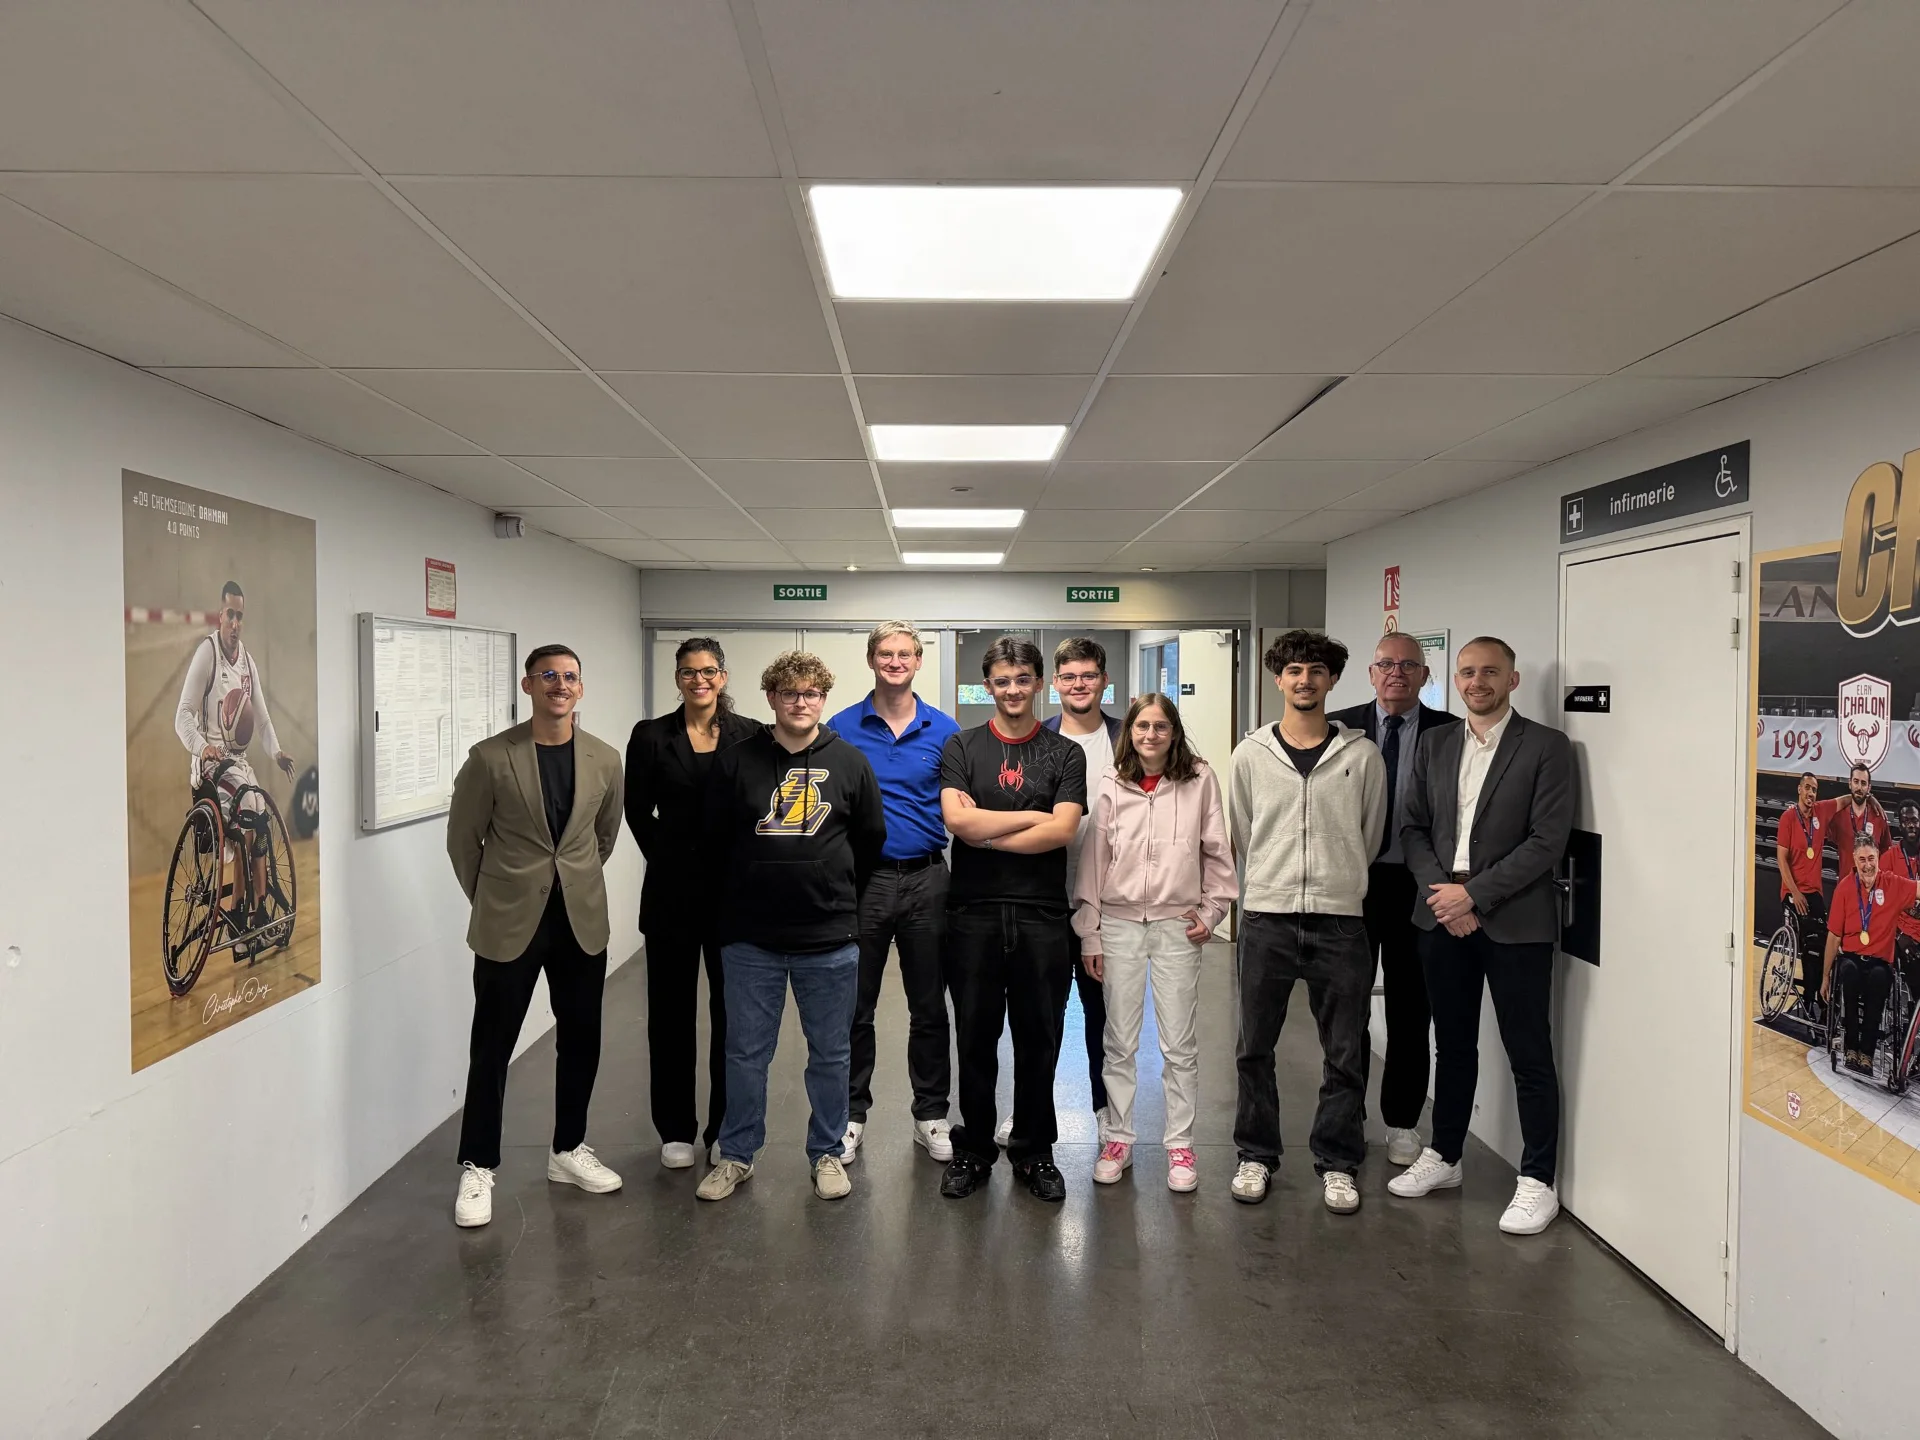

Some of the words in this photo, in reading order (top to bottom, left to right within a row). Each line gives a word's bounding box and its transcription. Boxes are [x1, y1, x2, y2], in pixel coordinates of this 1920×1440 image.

[133, 491, 148, 507] #09
[1610, 482, 1675, 516] infirmerie
[167, 520, 177, 535] 4.0
[179, 522, 200, 539] POINTS
[779, 588, 822, 598] SORTIE
[1071, 590, 1114, 600] SORTIE
[1856, 684, 1872, 696] ELAN
[1843, 696, 1886, 721] CHALON
[1772, 729, 1823, 762] 1993
